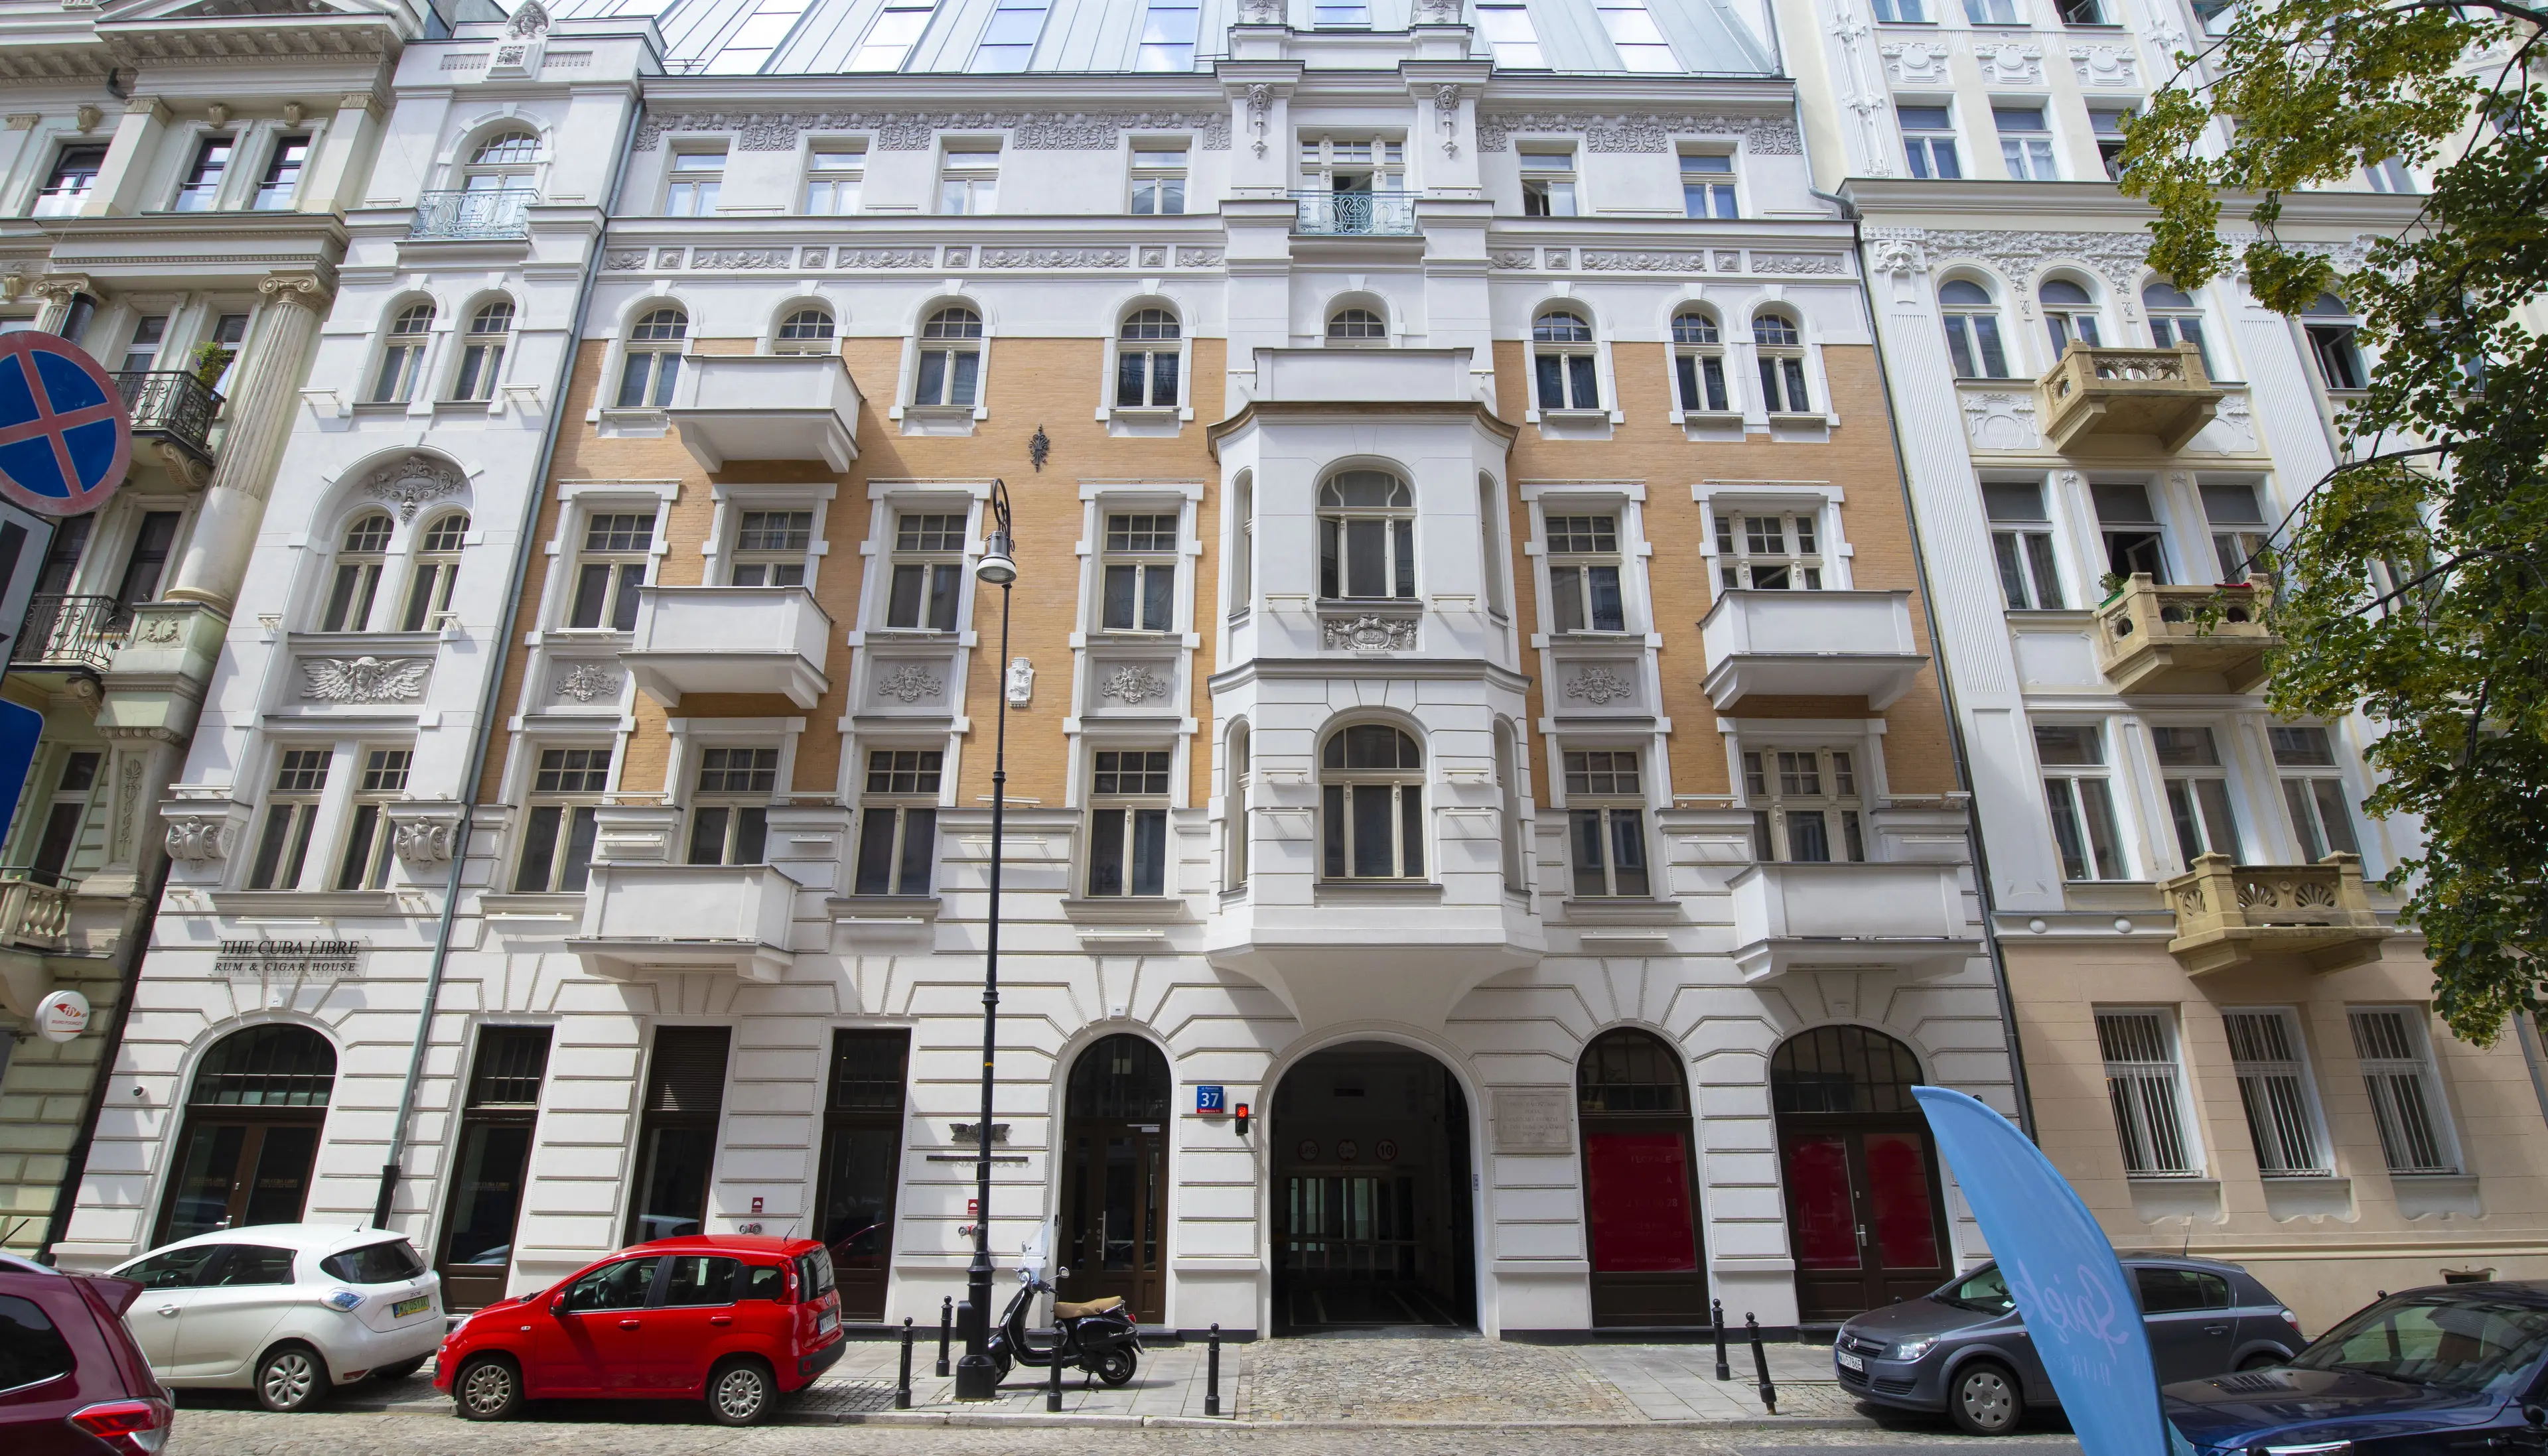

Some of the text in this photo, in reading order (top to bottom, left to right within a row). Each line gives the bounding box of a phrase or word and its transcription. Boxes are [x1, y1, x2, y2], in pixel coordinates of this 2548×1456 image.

[221, 941, 360, 955] THE CUBA LIBRE
[214, 962, 356, 971] RUM & CIGAR HOUSE
[1201, 1092, 1219, 1107] 37
[1380, 1145, 1393, 1156] 10
